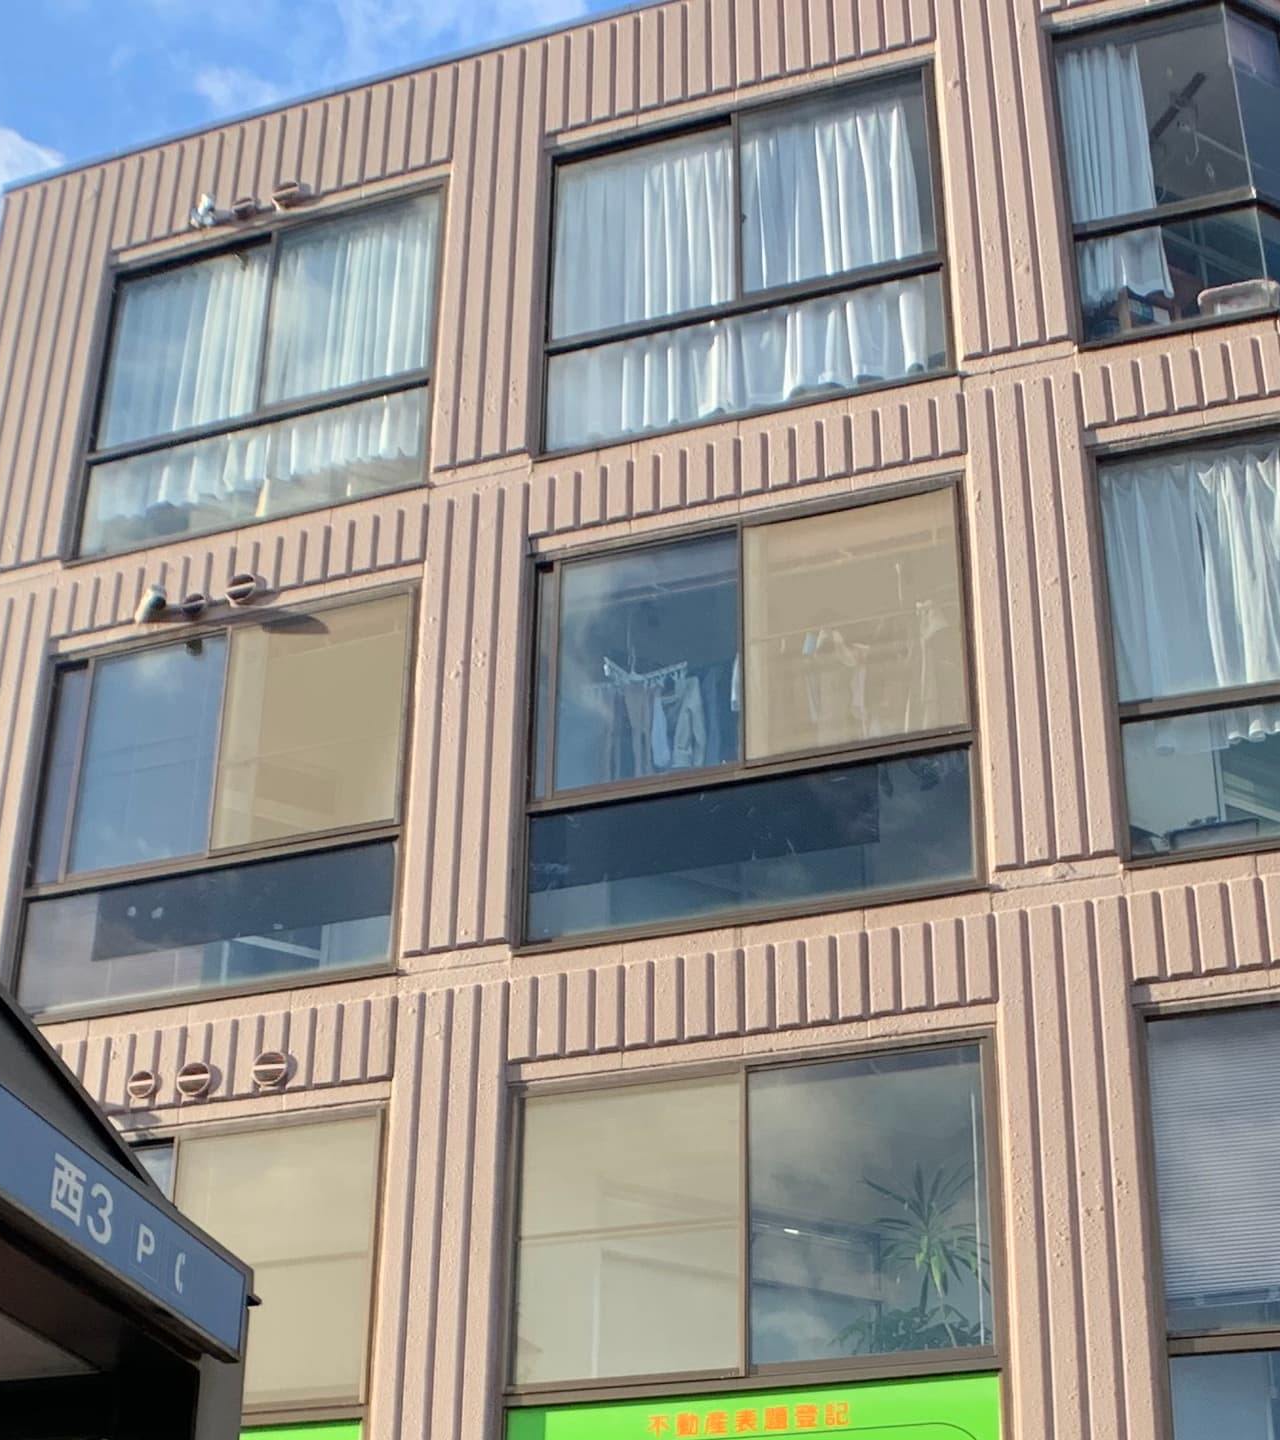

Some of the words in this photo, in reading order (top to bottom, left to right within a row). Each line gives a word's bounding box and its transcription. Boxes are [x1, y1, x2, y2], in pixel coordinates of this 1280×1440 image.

[50, 1152, 115, 1246] 西3
[647, 1401, 851, 1440] 不動産表題登記
